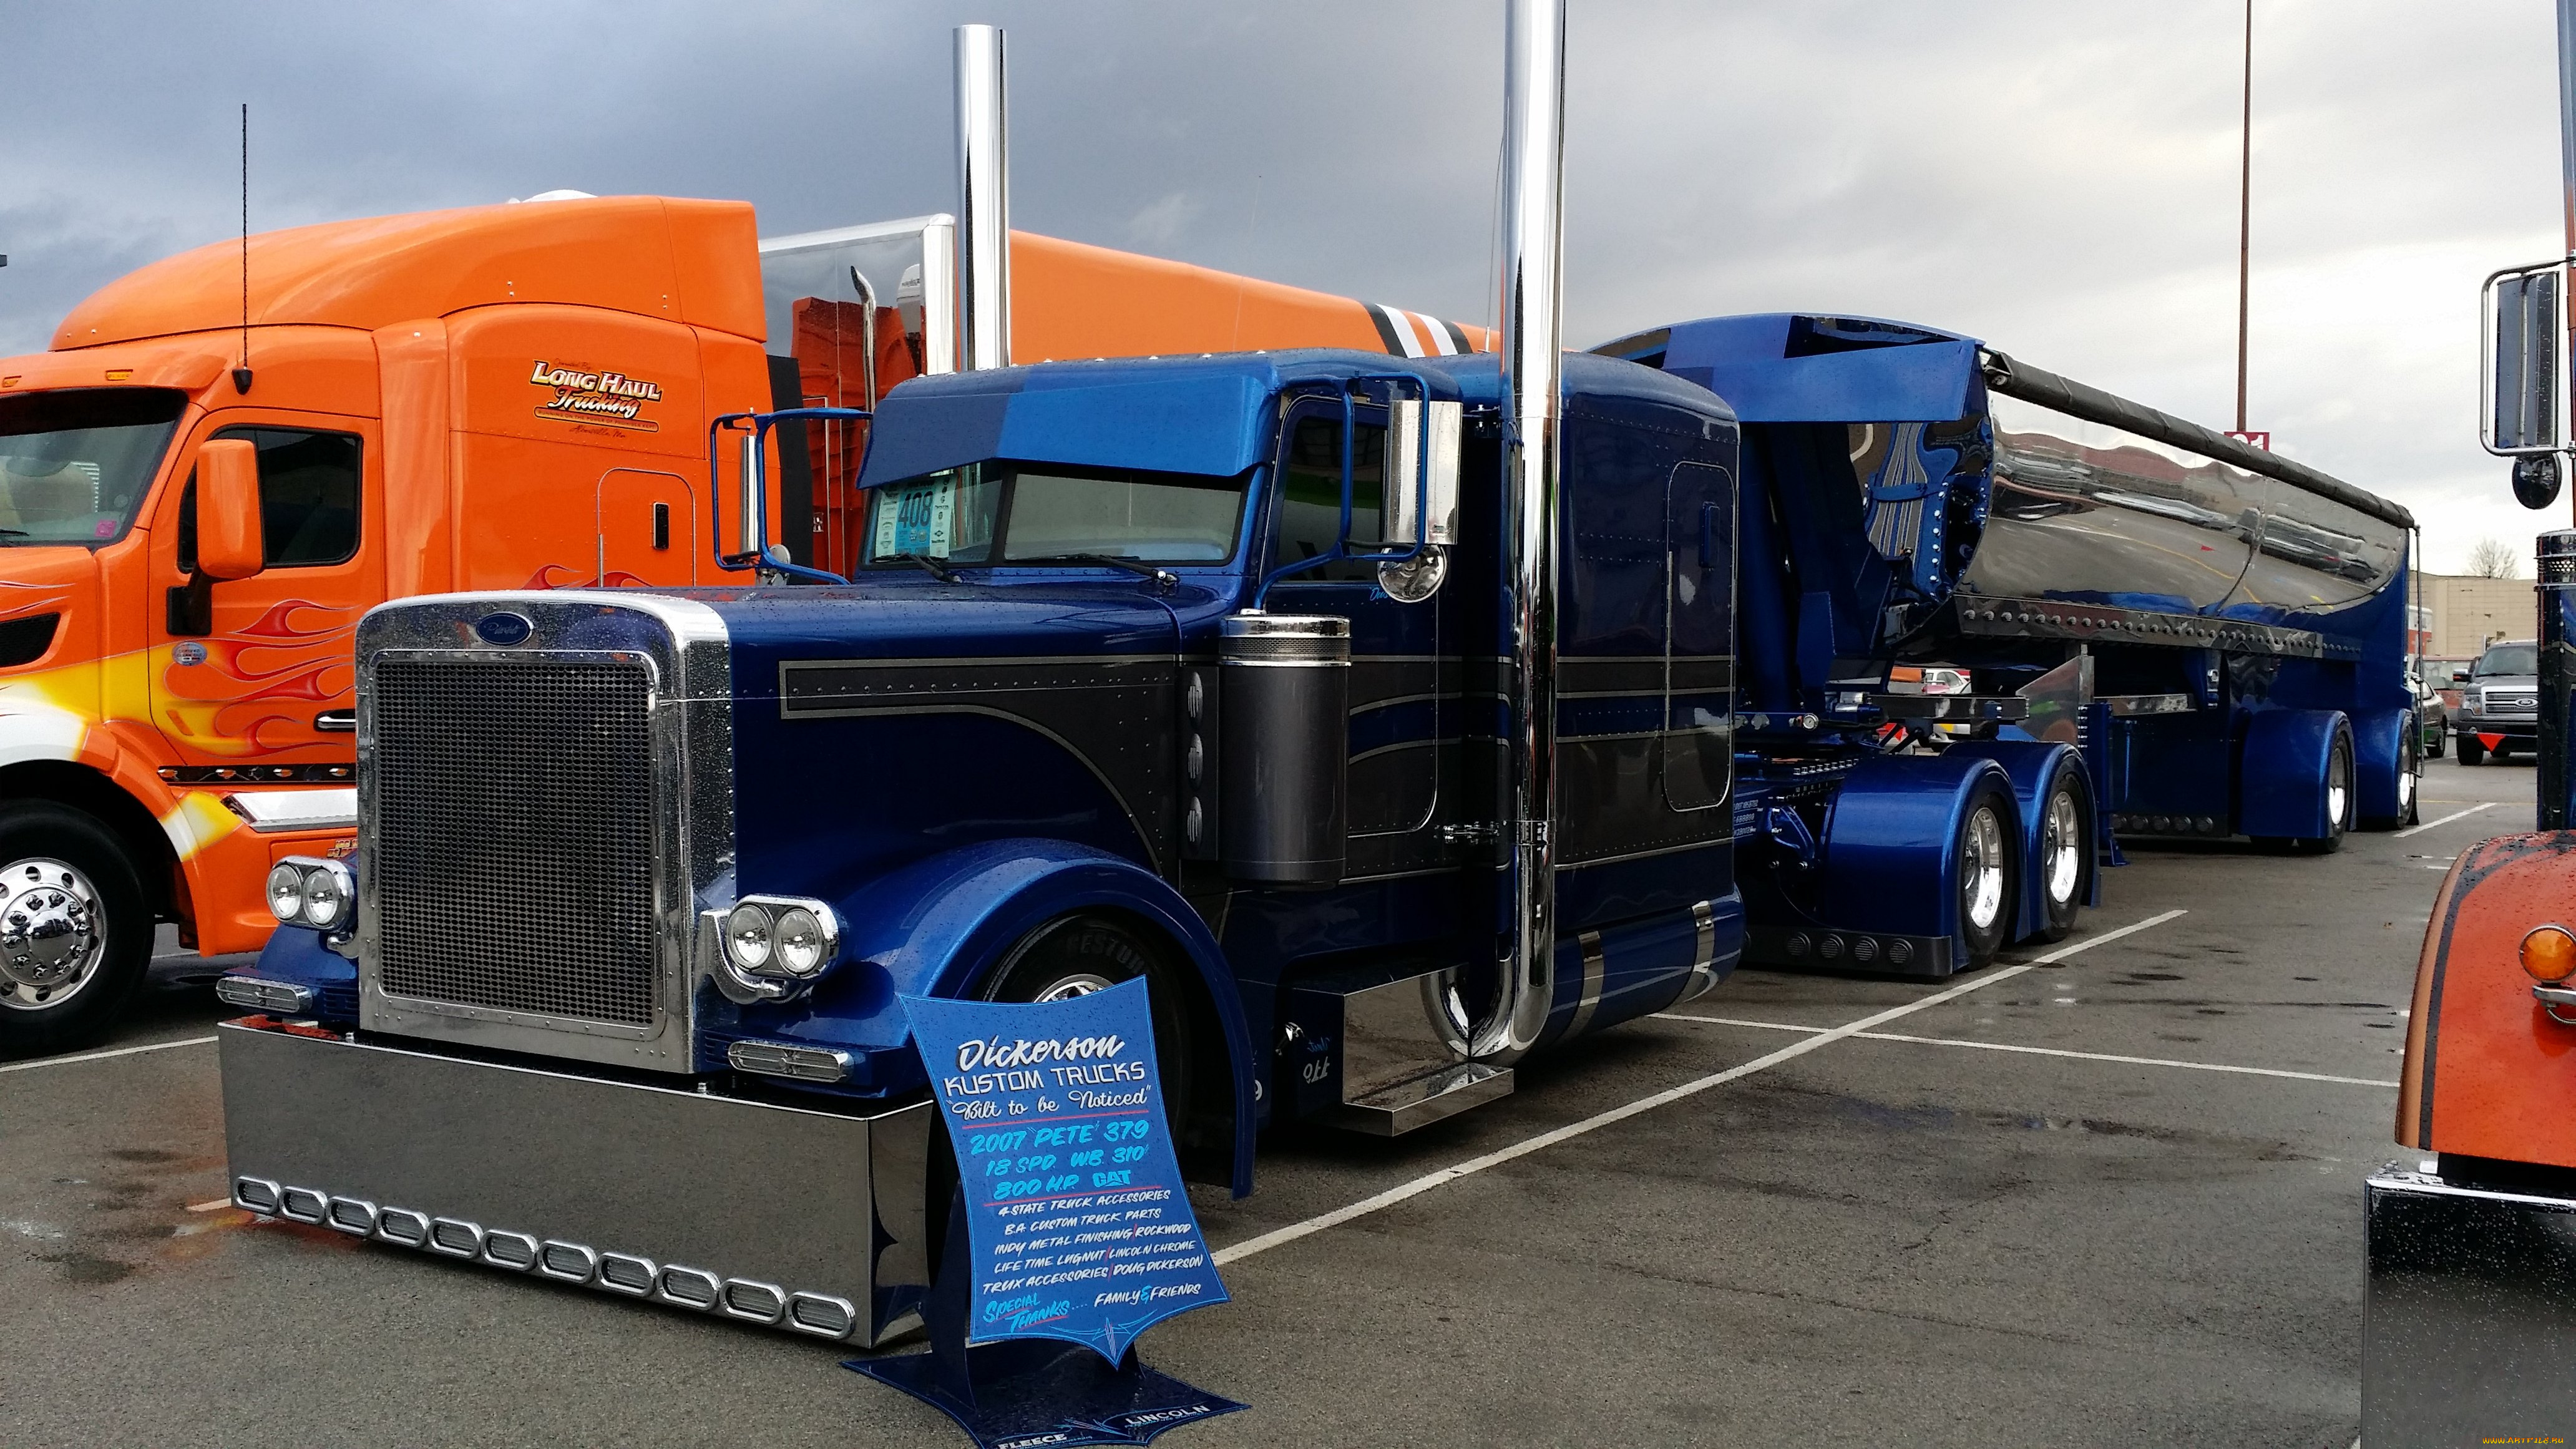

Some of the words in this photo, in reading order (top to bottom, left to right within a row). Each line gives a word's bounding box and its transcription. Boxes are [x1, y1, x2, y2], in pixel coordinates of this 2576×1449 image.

[530, 360, 599, 391] LONG
[598, 371, 663, 402] HAUL
[547, 385, 640, 419] Trucking
[898, 490, 934, 529] 408
[957, 1034, 1125, 1072] Dickerson
[944, 1069, 1045, 1097] KUSTOM
[1050, 1061, 1146, 1086] TRUCKS
[1008, 1100, 1028, 1116] to
[1038, 1096, 1059, 1113] be
[970, 1130, 1027, 1155] 2007
[1103, 1119, 1149, 1142] 379
[985, 1158, 1012, 1177] 18
[993, 1178, 1043, 1200] 800
[1092, 1169, 1131, 1188] CAT
[1050, 1196, 1093, 1211] TRUCK
[1096, 1189, 1171, 1207] ACCESSORIES
[1030, 1216, 1078, 1232] CUSTOM
[1080, 1212, 1122, 1226] TRUCK
[1125, 1208, 1162, 1221] PARTS
[993, 1259, 1023, 1274] LIFE
[1024, 1256, 1055, 1270] TIME
[1153, 1239, 1197, 1254] CHROME
[994, 1241, 1027, 1257] INDY
[1028, 1235, 1073, 1250] METAL
[982, 1277, 1025, 1295] TRUX
[1146, 1253, 1204, 1271] DICKERSON
[982, 1292, 1040, 1324] SPECIAL
[1124, 1404, 1211, 1427] LINCOLN
[997, 1433, 1068, 1449] FLEECE
